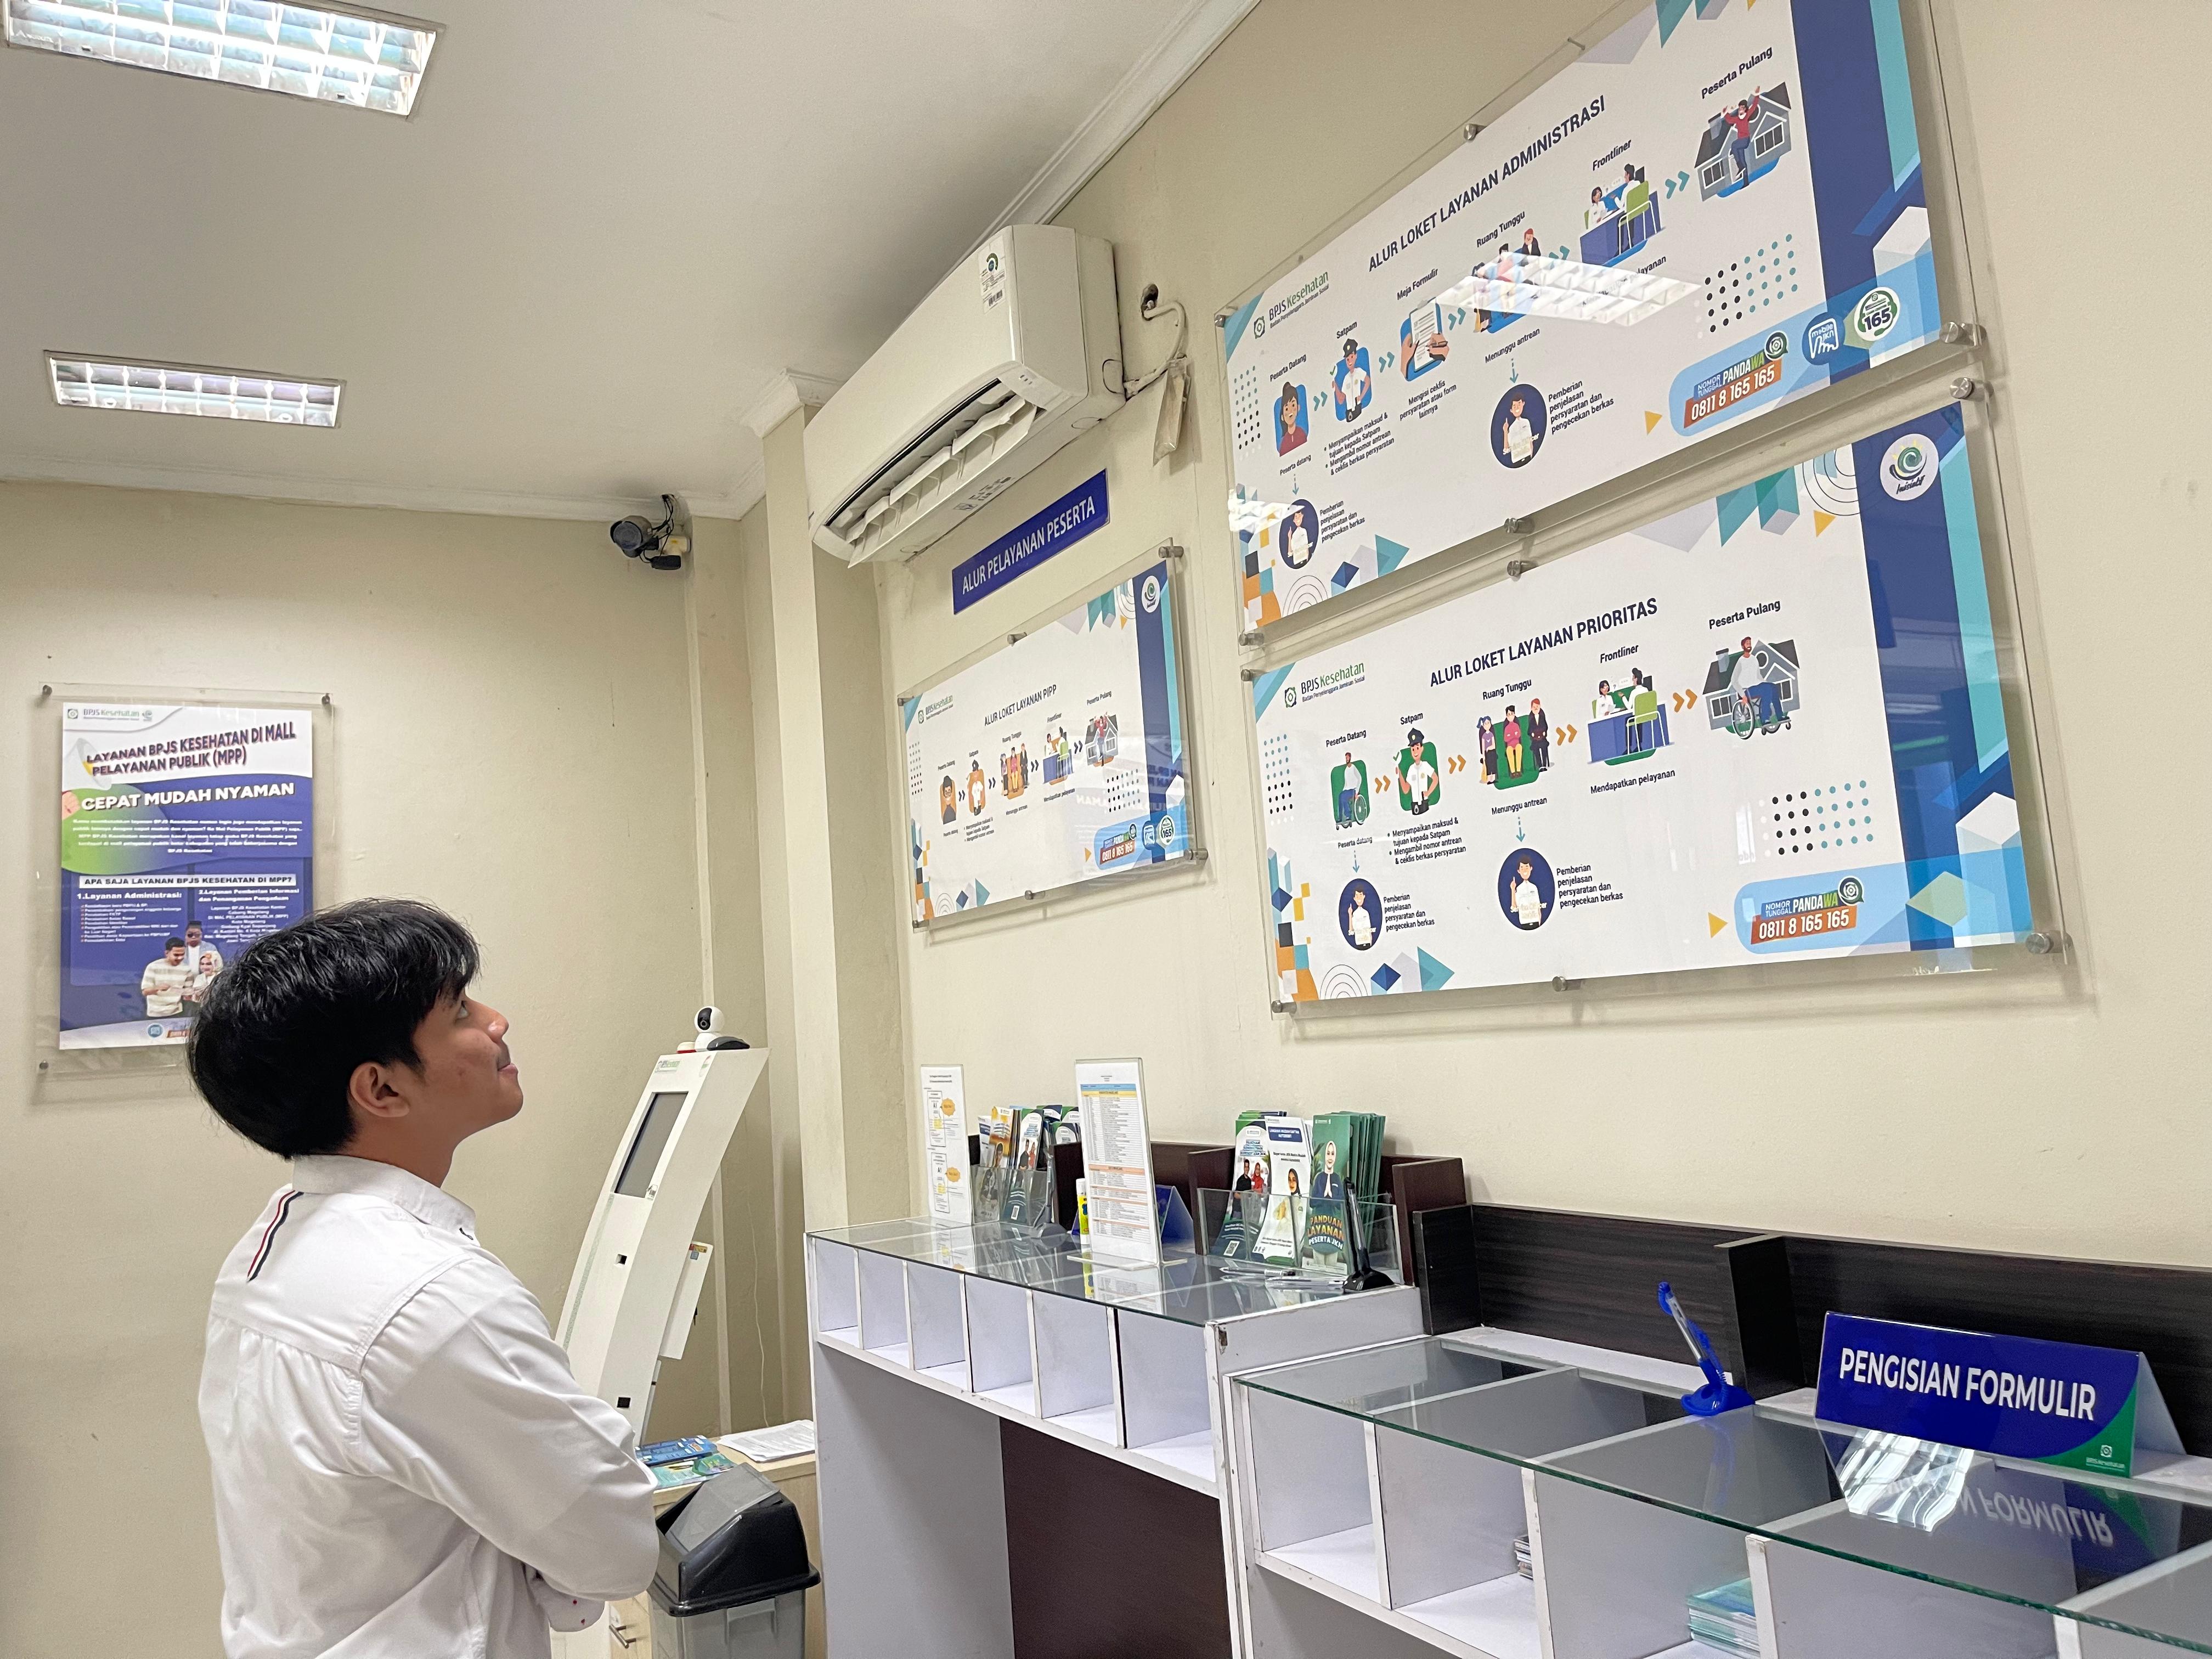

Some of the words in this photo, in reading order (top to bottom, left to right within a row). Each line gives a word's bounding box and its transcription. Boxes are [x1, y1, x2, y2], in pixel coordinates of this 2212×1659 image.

[1702, 71, 1737, 99] Peserta
[1739, 47, 1772, 74] Pulang
[1593, 140, 1632, 171] Frontliner
[1369, 241, 1398, 272] ALUR
[1401, 212, 1437, 250] LOKET
[1440, 170, 1498, 223] LAYANAN
[1503, 95, 1605, 180] ADMINISTRASI
[1476, 228, 1498, 247] Ruang
[1499, 211, 1525, 233] Tunggu
[1397, 286, 1411, 301] Meja
[1412, 268, 1438, 291] Formulir
[1269, 300, 1286, 321] BPJS
[1286, 272, 1328, 308] Kesehatan
[1336, 321, 1357, 338] Satpam
[1864, 308, 1891, 330] 165
[1485, 342, 1516, 363] Menunggu
[1517, 328, 1540, 346] antrean
[1269, 365, 1288, 382] Peserta
[1289, 354, 1306, 370] Datang
[1697, 374, 1720, 391] NOMOR
[1723, 352, 1765, 385] PANDAWA
[1408, 388, 1429, 405] Mengisi
[1430, 380, 1446, 393] ceklis
[1549, 380, 1583, 402] Pemberian
[1691, 394, 1716, 420] 0811
[1718, 390, 1726, 407] 8
[1730, 377, 1750, 402] 165
[1754, 364, 1775, 390] 165
[1697, 382, 1722, 397] TUNGGAL
[1400, 399, 1430, 421] persyaratan
[1431, 391, 1443, 403] atau
[1443, 383, 1457, 395] form
[1419, 404, 1438, 419] lainnya
[1549, 391, 1584, 414] penjelasan
[1550, 400, 1588, 425] persyaratan
[1590, 392, 1602, 404] dan
[1551, 410, 1590, 435] pengecekan
[1591, 398, 1614, 414] berkas
[1328, 427, 1363, 450] Menyampaikan
[1364, 414, 1383, 430] maksud
[1329, 447, 1344, 458] tujuan
[1344, 437, 1361, 449] kepada
[1362, 426, 1380, 440] Satpam
[1330, 449, 1355, 467] Mengambil
[1356, 441, 1371, 453] nomor
[1372, 430, 1391, 444] antrean
[1335, 461, 1348, 473] ceklis
[1349, 453, 1365, 466] berkas
[1366, 438, 1395, 459] persyaratan
[1280, 463, 1296, 476] Peserta
[1296, 455, 1311, 467] datang
[1320, 500, 1344, 516] Pemberian
[1321, 509, 1345, 526] penjelasan
[1322, 517, 1347, 535] persyaratan
[1348, 512, 1357, 521] dan
[1322, 525, 1348, 544] pengecekan
[1350, 517, 1365, 529] berkas
[962, 565, 987, 595] ALUR
[988, 528, 1045, 577] PELAYANAN
[1047, 495, 1096, 538] PESERTA
[1709, 612, 1745, 629] Peserta
[1746, 601, 1781, 618] Pulang
[1430, 664, 1463, 687] ALUR
[1465, 648, 1505, 676] LOKET
[1509, 625, 1573, 661] LAYANAN
[1577, 597, 1657, 639] PRIORITAS
[1600, 645, 1639, 663] Frontliner
[1301, 678, 1319, 694] BPJS
[1319, 663, 1364, 687] Kesehatan
[1483, 687, 1504, 700] Ruang
[1505, 679, 1532, 693] Tunggu
[985, 712, 998, 726] ALUR
[998, 703, 1015, 720] LOKET
[1017, 691, 1042, 712] LAYANAN
[1043, 685, 1057, 699] PIPP
[1401, 713, 1423, 725] Satpam
[87, 746, 146, 764] LAYANAN
[149, 741, 178, 757] BPJS
[180, 729, 249, 752] KESEHATAN
[251, 727, 263, 742] DI
[265, 721, 297, 741] MALL
[1326, 736, 1346, 747] Peserta
[1347, 730, 1367, 741] Datang
[93, 760, 165, 777] PELAYANAN
[169, 753, 211, 769] PUBLIK
[212, 745, 247, 768] (MPP)
[1590, 778, 1637, 794] Mendapatkan
[1638, 770, 1675, 786] pelayanan
[81, 794, 141, 811] CEPAT
[144, 788, 211, 806] MUDAH
[215, 782, 295, 801] NYAMAN
[1492, 803, 1522, 815] Menunggu
[1524, 797, 1547, 808] antrean
[1163, 828, 1172, 838] 165
[1392, 824, 1431, 837] Menyampaikan
[1432, 819, 1453, 829] maksud
[1393, 838, 1409, 847] tujuan
[1410, 833, 1429, 843] kepada
[1430, 829, 1450, 839] Satpam
[1102, 850, 1111, 861] 0811
[1112, 849, 1116, 858] 8
[1125, 842, 1133, 854] 165
[1338, 840, 1356, 849] Peserta
[1356, 836, 1373, 845] datang
[1394, 843, 1422, 856] Mengambil
[1441, 837, 1462, 846] antrean
[1400, 855, 1414, 864] ceklis
[1416, 852, 1433, 861] berkas
[1434, 846, 1466, 859] persyaratan
[1556, 864, 1591, 876] Pemberian
[1558, 875, 1593, 888] penjelasan
[1559, 885, 1597, 899] persyaratan
[1599, 882, 1611, 891] dan
[1384, 894, 1410, 903] Pemberian
[1384, 903, 1411, 913] penjelasan
[1560, 895, 1599, 909] pengecekan
[1600, 891, 1623, 901] berkas
[1765, 900, 1791, 911] NOMOR
[1793, 892, 1838, 913] PANDAWA
[1385, 912, 1414, 923] persyaratan
[1759, 919, 1785, 939] 0811
[1788, 917, 1797, 935] 8
[1801, 913, 1822, 933] 165
[1827, 909, 1849, 929] 165
[1765, 909, 1792, 917] TUNGGAL
[1386, 921, 1416, 932] pengecekan
[1417, 918, 1435, 926] berkas
[1307, 1224, 1344, 1241] LAYANAN
[1310, 1215, 1342, 1228] PANDUAN
[1308, 1235, 1330, 1245] PESERTA
[1331, 1239, 1344, 1250] JKN
[1840, 1347, 1960, 1398] PENGISIAN
[1966, 1368, 2096, 1421] FORMULIR
